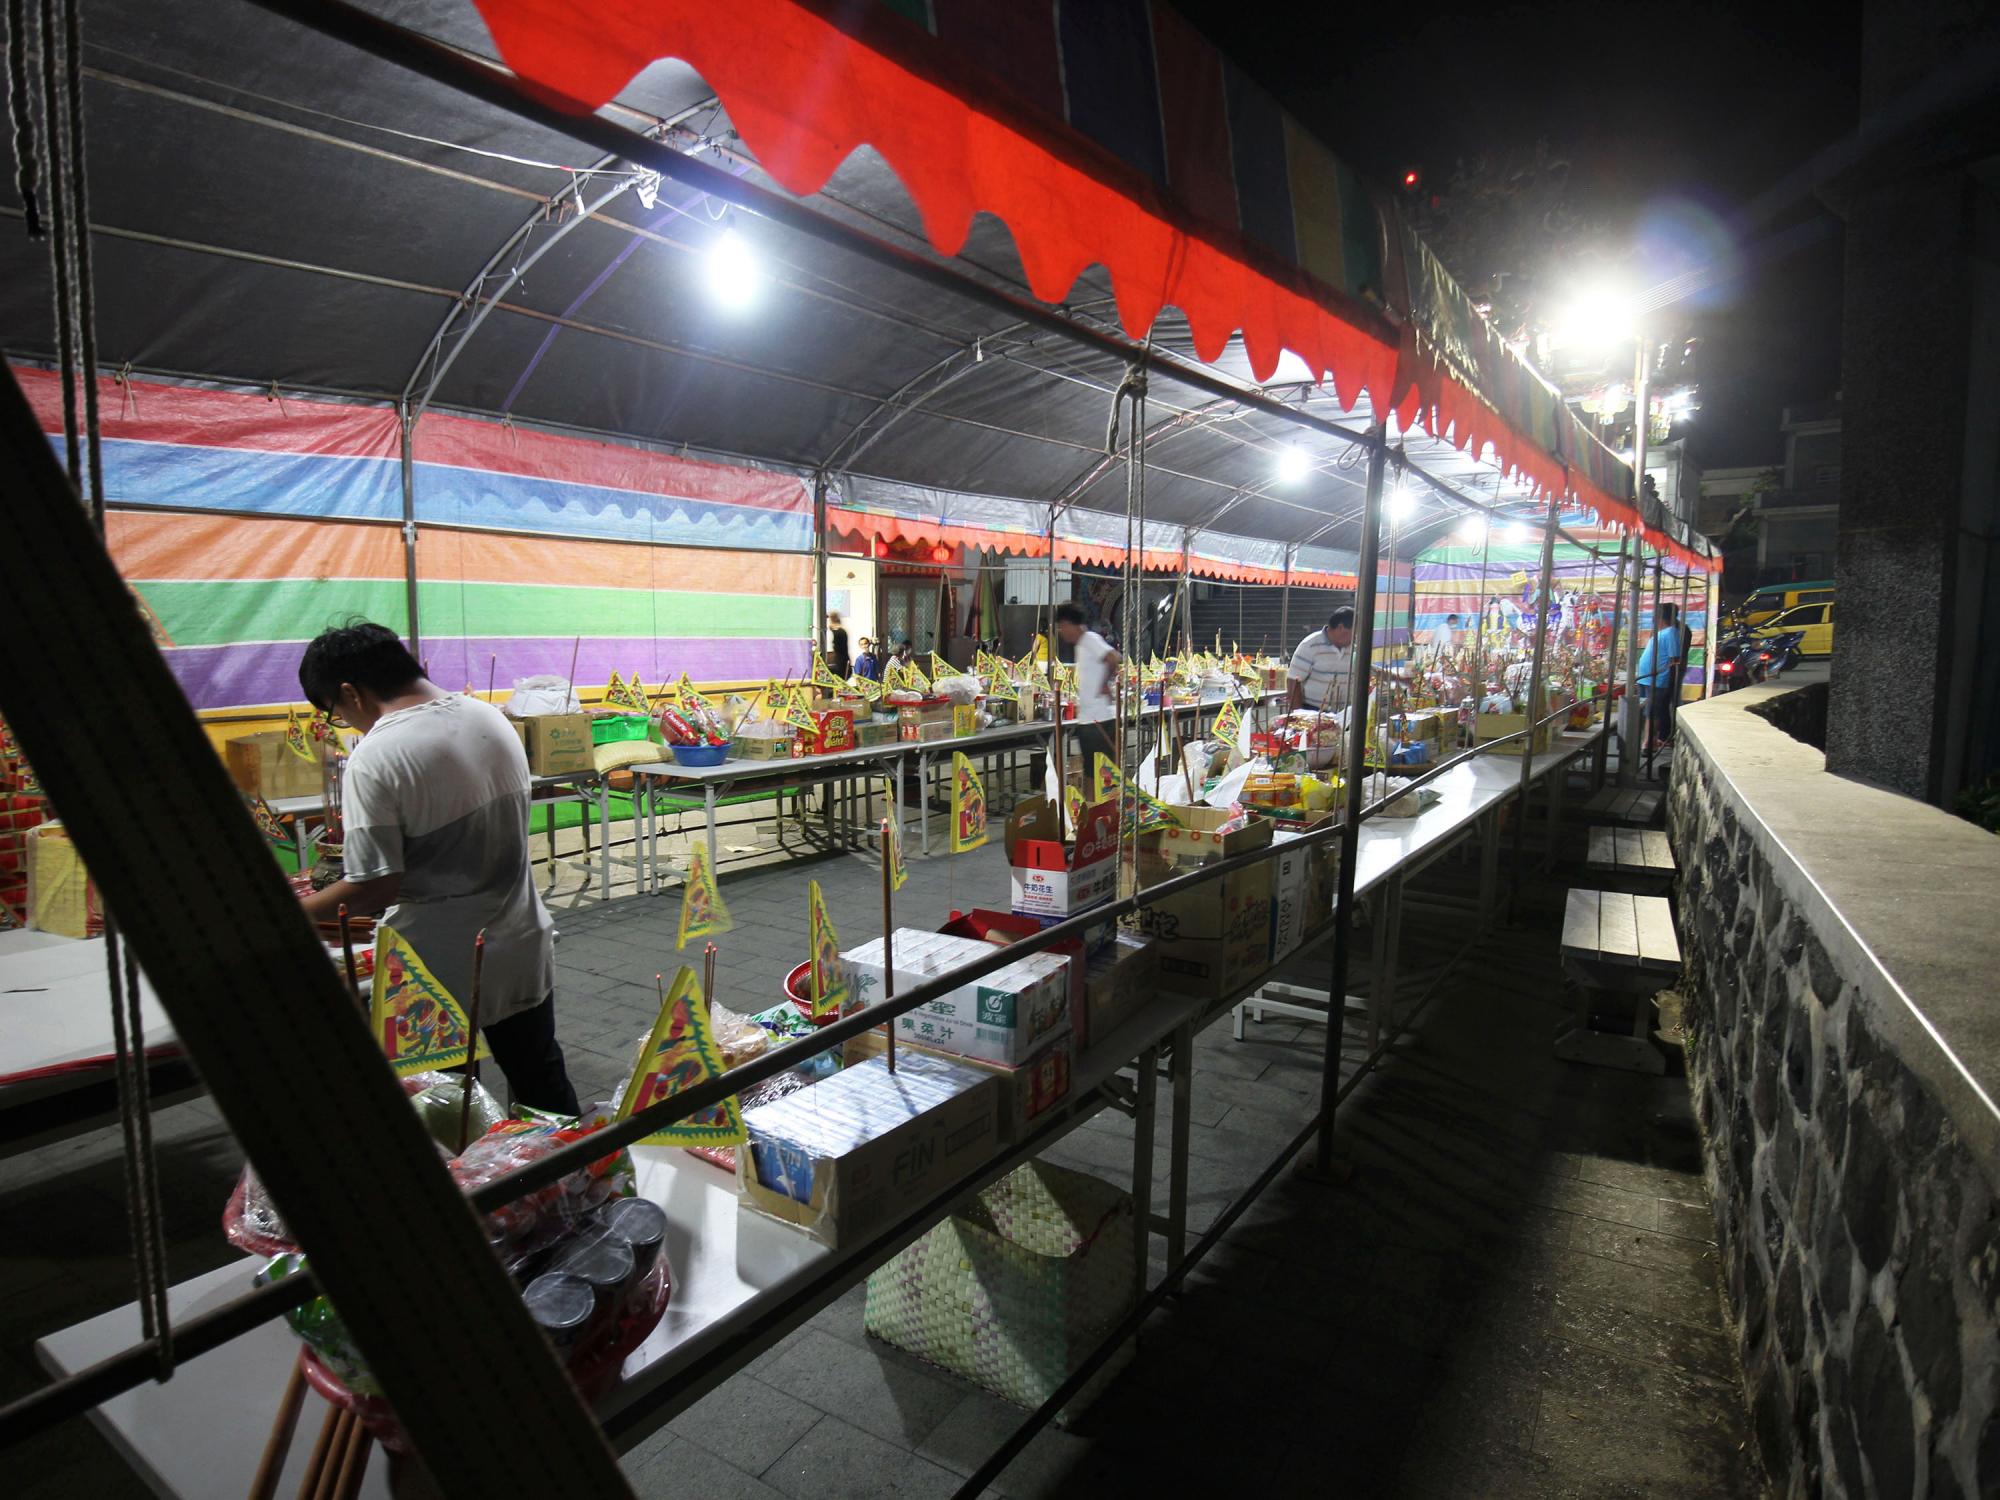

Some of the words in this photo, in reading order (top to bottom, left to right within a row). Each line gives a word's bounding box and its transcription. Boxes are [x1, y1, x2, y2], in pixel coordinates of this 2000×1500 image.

[1023, 882, 1054, 894] 牛奶花生
[902, 1017, 955, 1039] 果菜汁
[893, 1138, 935, 1185] FIN
